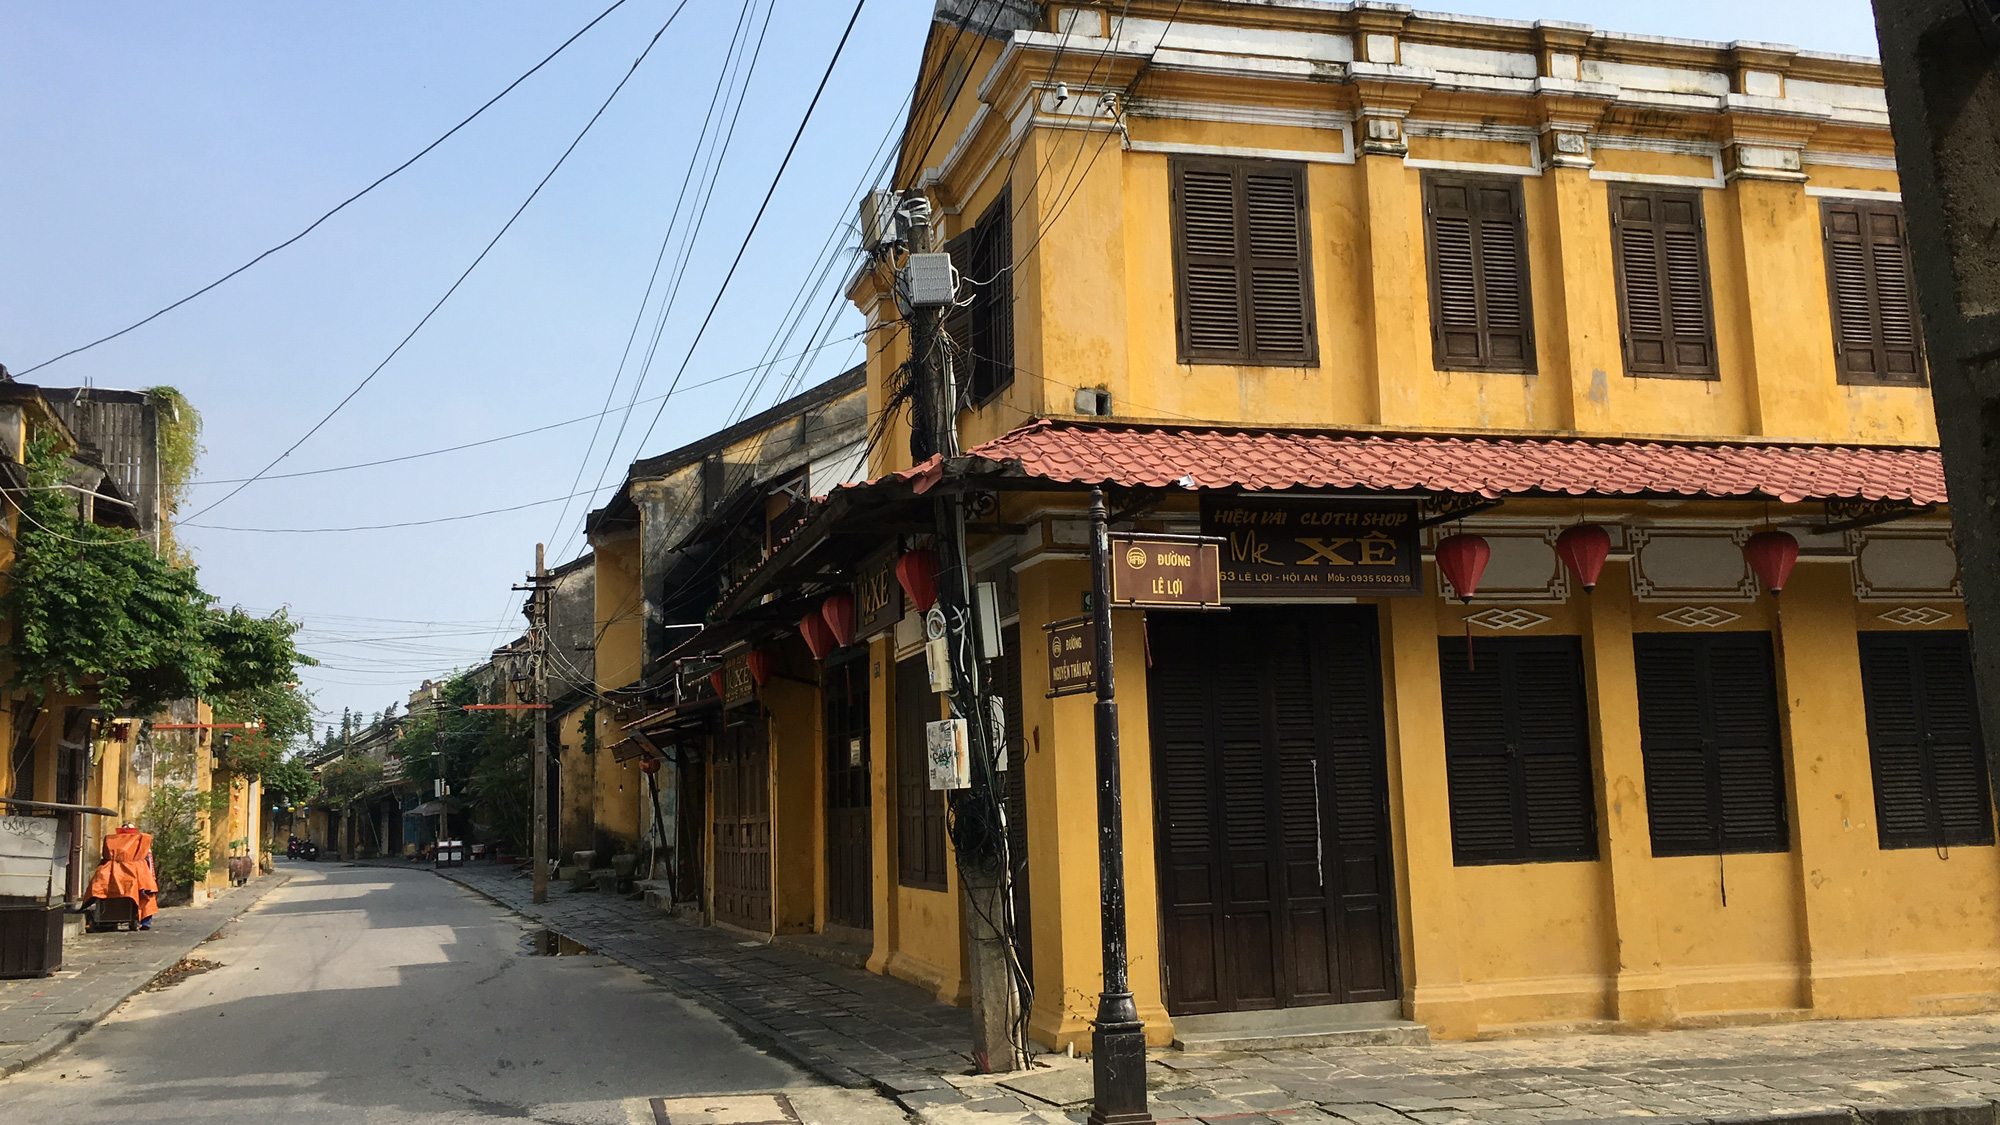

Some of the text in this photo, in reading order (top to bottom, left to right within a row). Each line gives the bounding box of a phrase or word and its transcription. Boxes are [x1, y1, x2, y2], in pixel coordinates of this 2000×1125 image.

[1214, 508, 1408, 527] HIỆU VẢI CLOTH SHOP
[1294, 530, 1397, 566] XÊ
[1157, 550, 1191, 567] ĐƯỜNG
[1219, 571, 1236, 582] 63
[1238, 571, 1252, 582] LÊ
[1255, 572, 1273, 583] LỢI
[1282, 572, 1300, 583] HỘI
[1303, 574, 1318, 582] AN
[1152, 576, 1183, 598] LÊ LỢI
[1066, 635, 1082, 650] ĐƯỜNG
[1053, 660, 1070, 681] NGUYỄN
